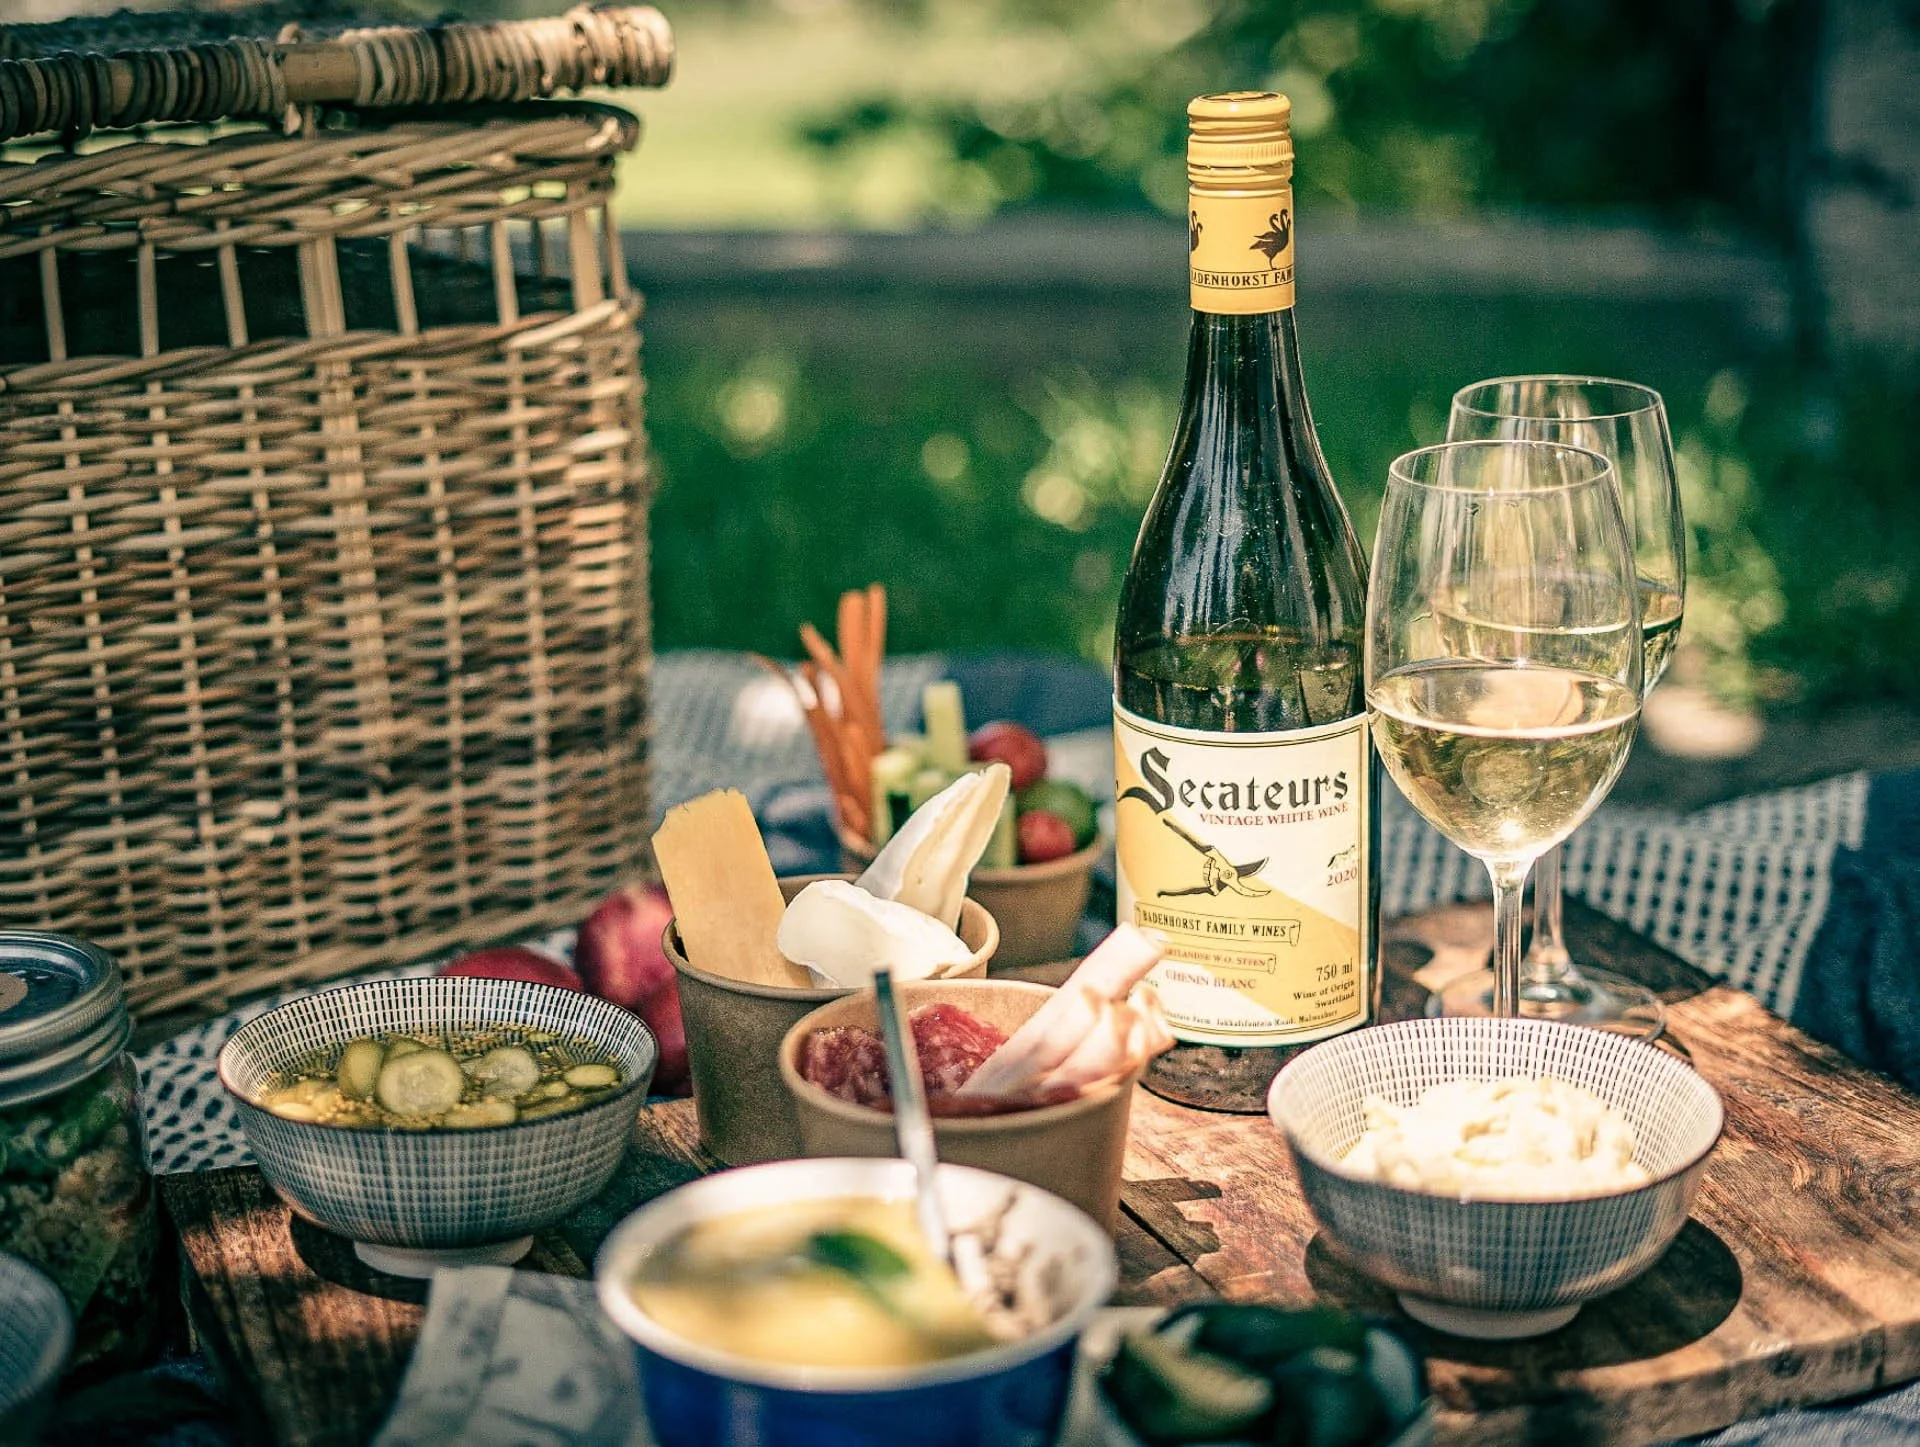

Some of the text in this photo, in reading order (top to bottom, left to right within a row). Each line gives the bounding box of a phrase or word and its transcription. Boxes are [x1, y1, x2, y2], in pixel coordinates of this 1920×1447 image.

[1191, 269, 1269, 287] ADENHORST
[1117, 747, 1349, 815] Secateurs
[1200, 802, 1349, 826] VINTAGE WHITE WINE
[1327, 866, 1358, 887] 2020
[1142, 909, 1287, 938] BADENHORST FAMILY WINES
[1236, 957, 1266, 968] STEEN
[1315, 957, 1353, 983] 750 ml
[1165, 968, 1210, 986] CHENIN
[1214, 976, 1258, 990] BLANC
[1293, 979, 1355, 1001] Wine of Origin
[1314, 991, 1355, 1009] Swartland
